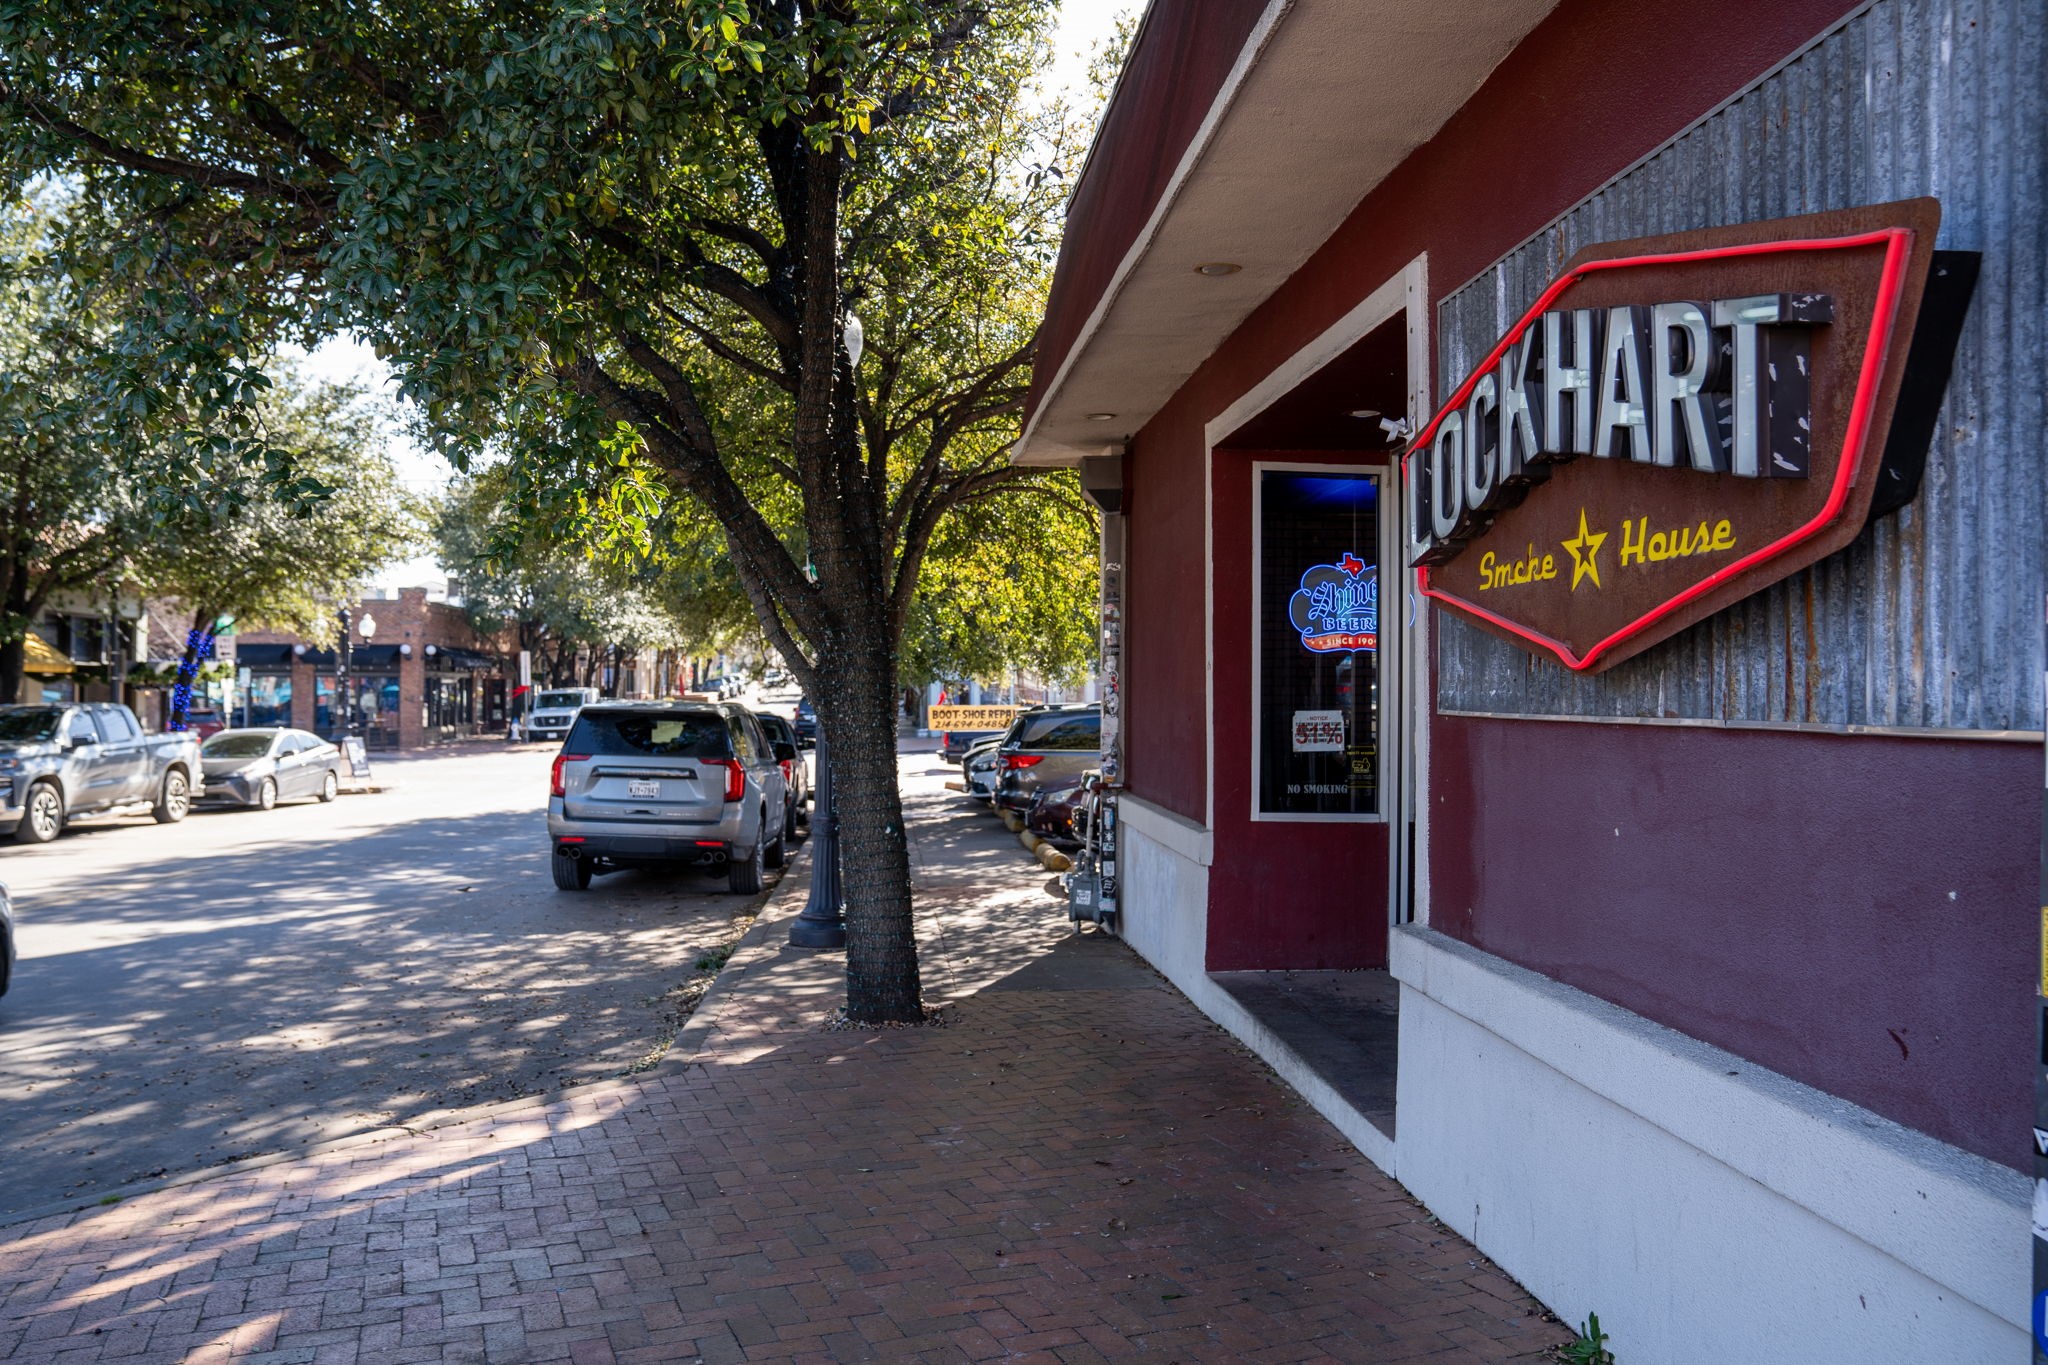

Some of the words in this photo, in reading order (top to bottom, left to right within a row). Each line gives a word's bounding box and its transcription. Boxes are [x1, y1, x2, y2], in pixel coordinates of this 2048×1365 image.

[1407, 291, 1800, 568] LOCKHART
[1620, 516, 1736, 566] House
[1326, 638, 1353, 646] SINCE
[1296, 723, 1343, 744] 51%
[1287, 784, 1301, 794] NO
[1303, 784, 1348, 794] SMOKING
